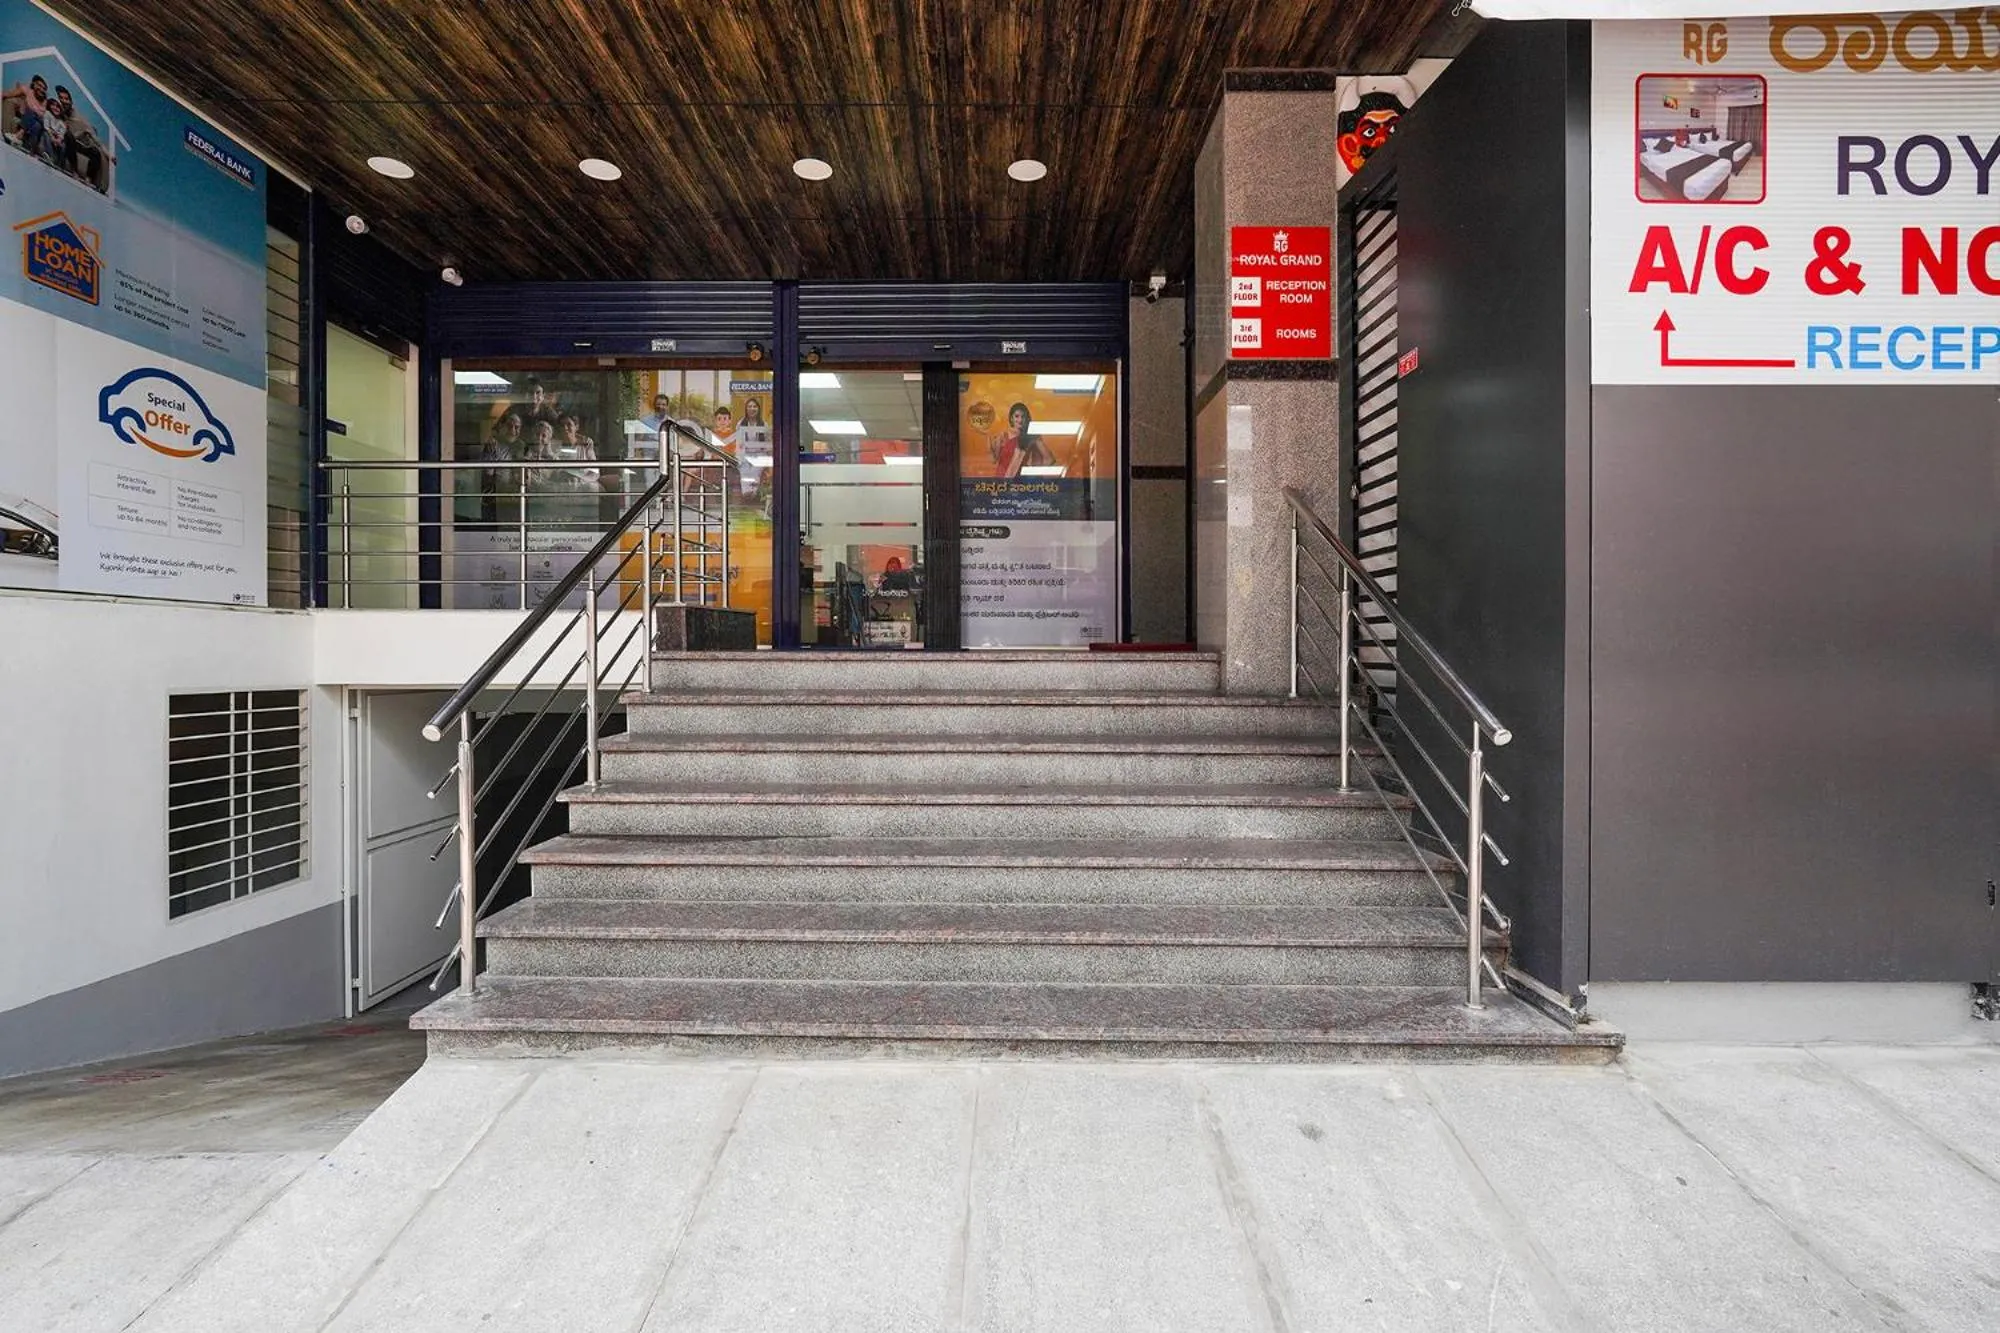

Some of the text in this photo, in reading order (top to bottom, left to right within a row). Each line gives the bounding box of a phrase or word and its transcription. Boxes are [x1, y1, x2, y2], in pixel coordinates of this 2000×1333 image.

[1683, 23, 1728, 65] RG
[188, 131, 226, 164] FEDERAL
[226, 157, 252, 181] BANK
[1837, 134, 2000, 196] ROY
[34, 232, 92, 269] HOME
[34, 247, 92, 284] LOAN
[1240, 254, 1278, 266] ROYAL
[1280, 254, 1322, 266] GRAND
[1628, 225, 1770, 296] A/C
[1804, 226, 1866, 296] &
[1239, 282, 1253, 290] 2nd
[1266, 280, 1326, 291] RECEPTION
[1234, 292, 1258, 301] FLOOR
[1280, 293, 1313, 303] ROOM
[1240, 324, 1252, 332] 3rd
[1276, 328, 1317, 339] ROOMS
[1234, 334, 1258, 343] FLOOR
[1807, 325, 2000, 370] RECEP
[731, 383, 757, 391] FEDERAL
[147, 392, 185, 412] Special
[145, 410, 191, 436] Offer
[117, 505, 138, 515] Tenure
[141, 556, 158, 565] these
